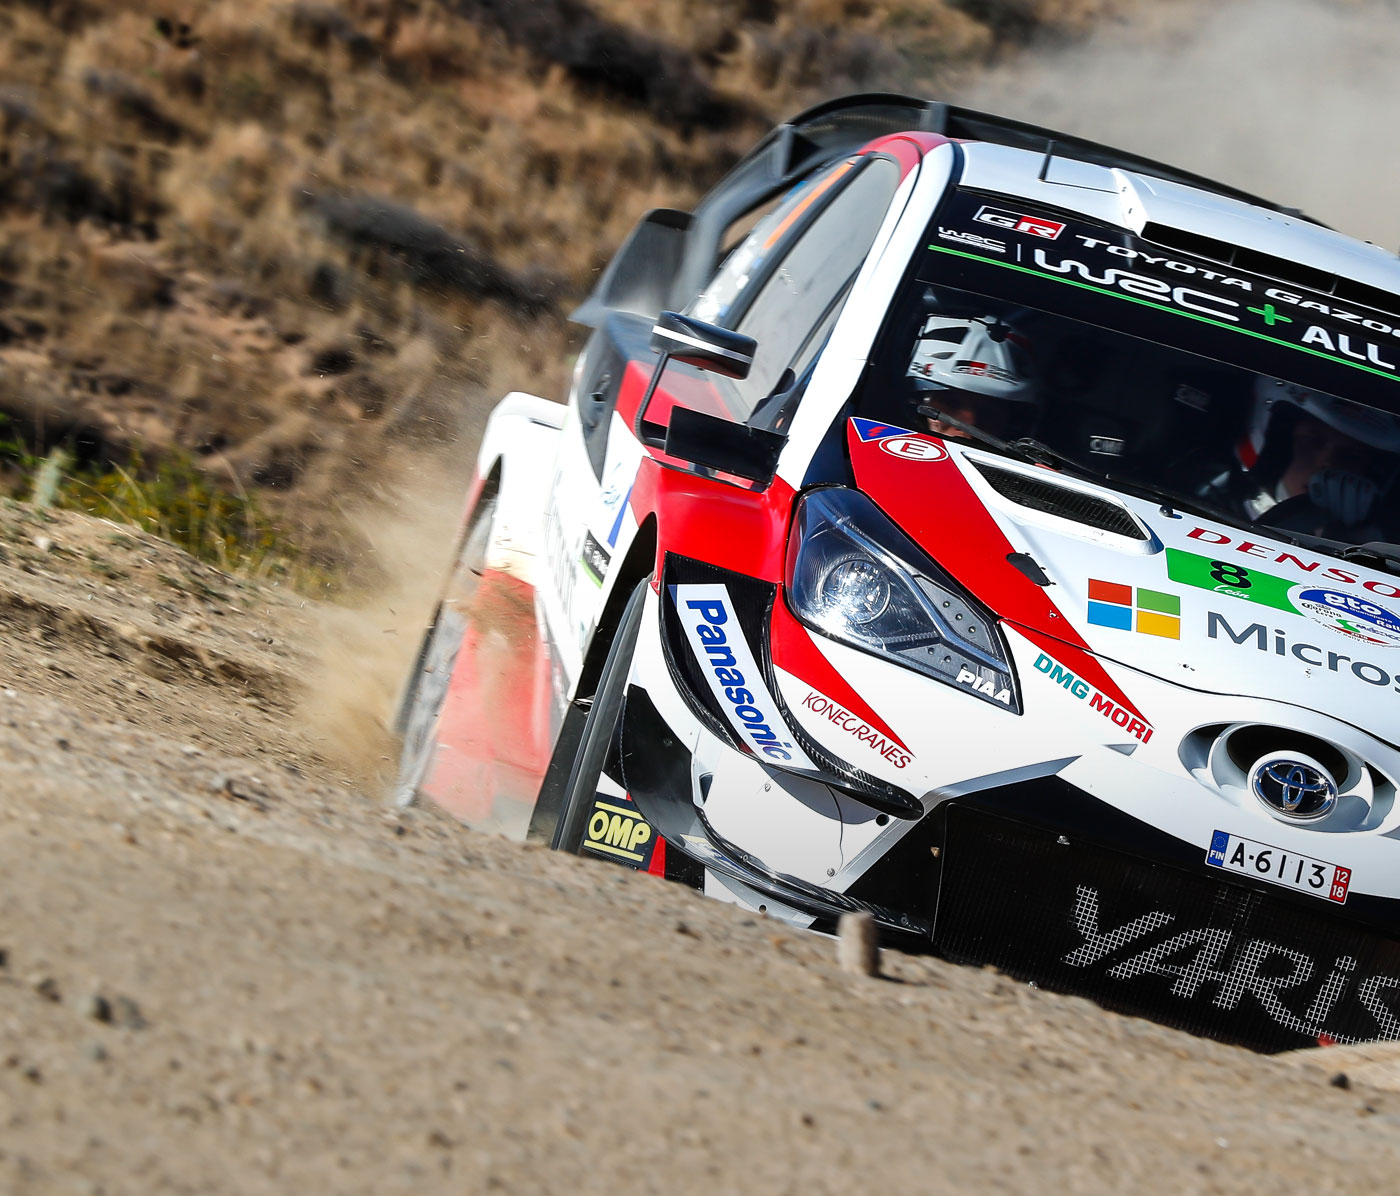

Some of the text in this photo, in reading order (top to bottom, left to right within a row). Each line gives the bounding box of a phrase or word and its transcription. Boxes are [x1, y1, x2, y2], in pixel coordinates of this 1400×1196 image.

[979, 211, 1057, 238] GR
[1075, 234, 1253, 292] TOYOTA
[1034, 248, 1240, 322] WRC
[1301, 325, 1396, 370] ALL
[1210, 560, 1252, 589] 8
[1324, 593, 1382, 616] gto
[686, 599, 791, 765] Panasonic
[955, 668, 1012, 706] PIAA
[1033, 653, 1154, 744] DMG MORI
[801, 691, 911, 770] KONECRANES
[588, 811, 651, 851] OMP
[1209, 849, 1225, 861] FIN
[1335, 869, 1349, 884] 12
[1332, 884, 1345, 898] 18
